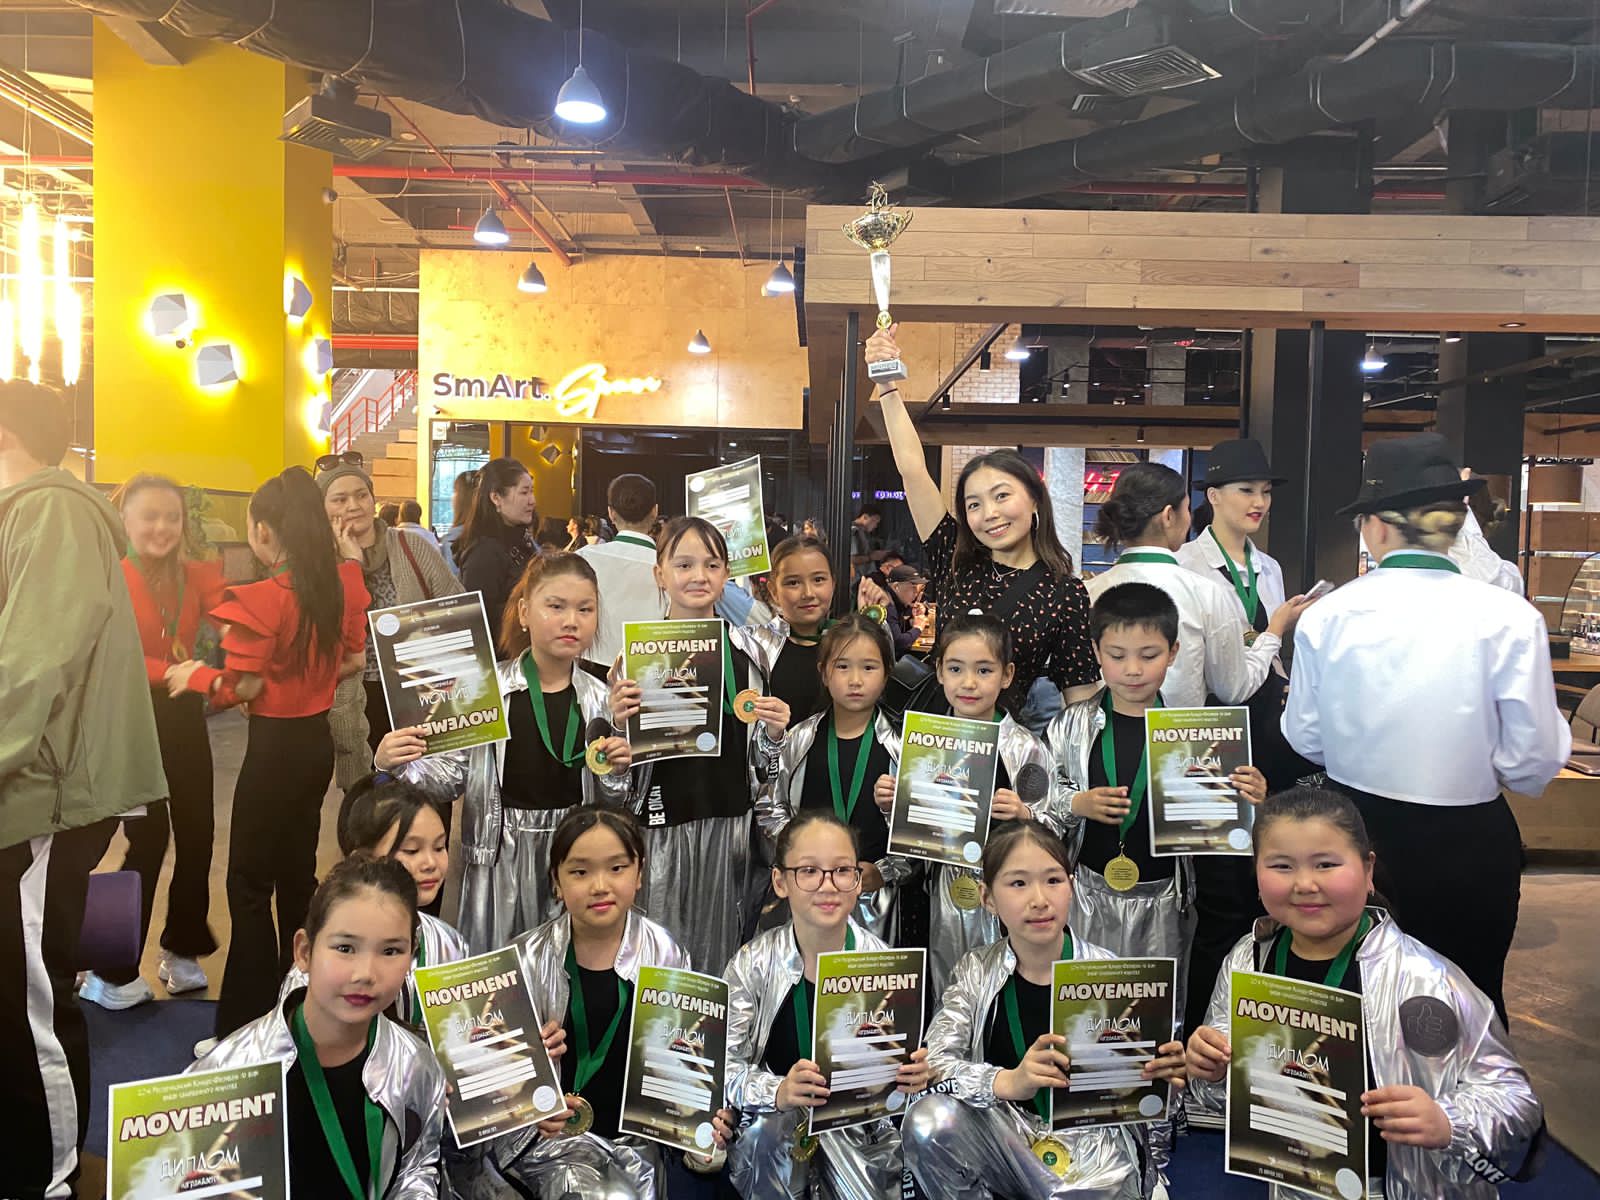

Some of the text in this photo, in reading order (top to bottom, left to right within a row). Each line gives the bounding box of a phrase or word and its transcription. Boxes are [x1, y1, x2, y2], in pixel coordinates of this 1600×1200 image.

[728, 543, 763, 561] MOVE
[630, 638, 718, 655] MOVEMENT
[907, 731, 994, 756] MOVEMENT
[1152, 727, 1244, 743] MOVEMENT
[648, 811, 666, 826] BE
[424, 970, 518, 1008] MOVEMENT
[821, 973, 919, 995] MOVEMENT
[1059, 981, 1168, 1001] MOVEMENT
[640, 987, 726, 1021] MOVEMENT
[845, 1009, 895, 1028] ДИПЛОМ
[1086, 1015, 1141, 1034] ДИПЛОМ
[1237, 997, 1358, 1042] MOVEMENT
[1266, 1043, 1330, 1072] ДИПЛОМ
[120, 1091, 277, 1142] MOVEMENT
[160, 1144, 240, 1182] ДИПЛОМ
[1464, 1150, 1505, 1183] LOVE
